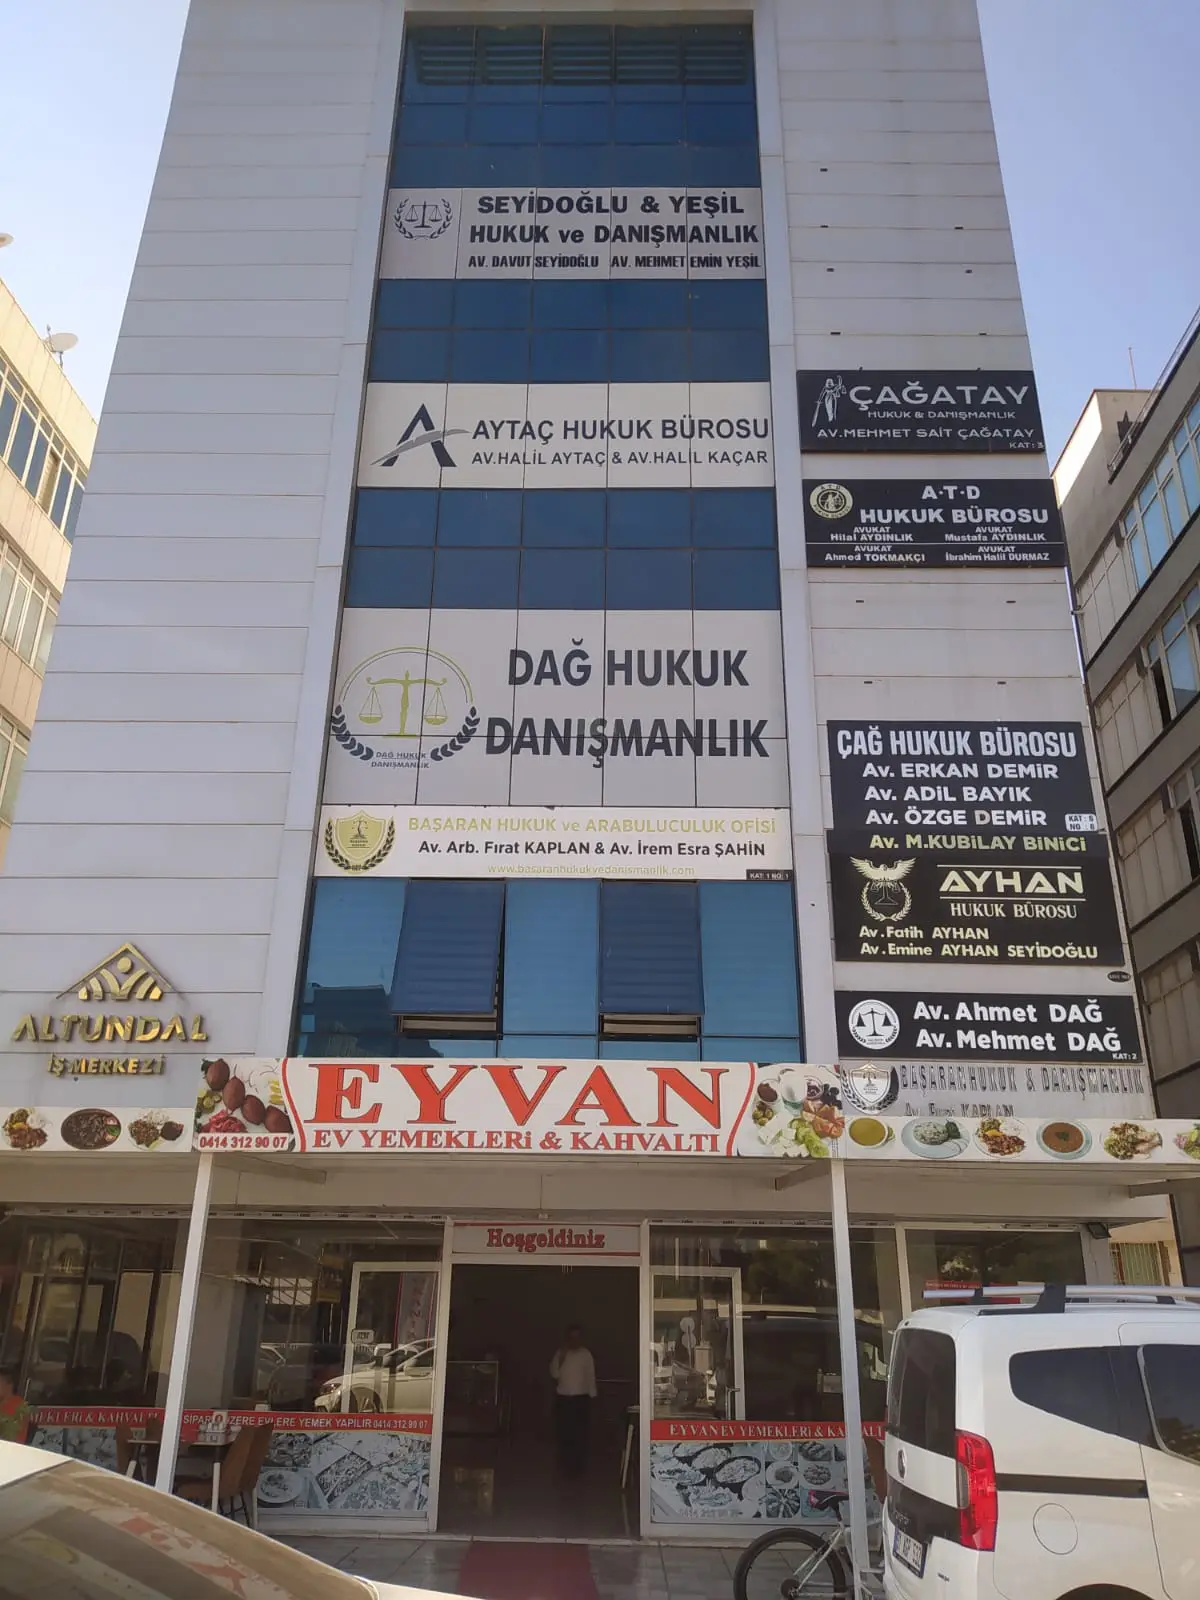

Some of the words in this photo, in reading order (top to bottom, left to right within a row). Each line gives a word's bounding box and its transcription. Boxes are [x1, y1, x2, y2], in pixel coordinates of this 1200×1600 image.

[478, 190, 628, 214] SEYİDOĞLU
[640, 195, 660, 214] &
[668, 191, 745, 219] YEŞİL
[470, 225, 550, 243] HUKUK
[558, 229, 585, 243] ve
[594, 225, 759, 248] DANIŞMANLIK
[468, 255, 489, 268] AV.
[491, 255, 532, 268] DAVUT
[535, 253, 599, 268] SEYİDOĞLU
[611, 255, 632, 268] AV.
[634, 255, 686, 268] MEHMET
[690, 253, 722, 268] EMİN
[726, 253, 761, 269] YEŞİL
[849, 381, 1029, 411] ÇAĞATAY
[867, 411, 911, 419] HUKUK
[914, 411, 925, 419] &
[928, 411, 1017, 421] DANIŞMANLIK
[472, 420, 554, 445] AYTAÇ
[563, 419, 653, 440] HUKUK
[661, 414, 769, 439] BÜROSU
[916, 427, 952, 438] SAİT
[958, 427, 1034, 440] ÇAĞATAY
[551, 451, 606, 467] AYTAÇ
[611, 451, 623, 465] &
[708, 451, 768, 466] KAÇAR
[860, 509, 945, 524] HUKUK
[951, 505, 1049, 524] BÜROSU
[830, 533, 857, 542] Hilal
[860, 534, 914, 542] AYDINLIK
[853, 526, 891, 534] AVUKAT
[945, 533, 988, 542] Mustafa
[991, 533, 1047, 542] AYDINLIK
[975, 526, 1013, 534] AVUKAT
[864, 553, 926, 562] TOKMAKÇI
[983, 552, 1007, 561] Halil
[1008, 552, 1050, 561] DURMAZ
[508, 637, 592, 687] DAĞ
[607, 649, 750, 687] HUKUK
[485, 717, 770, 768] DANIŞMANLIK
[837, 725, 883, 759] ÇAĞ
[890, 730, 974, 756] HUKUK
[980, 727, 1078, 757] BÜROSU
[397, 751, 427, 760] HUKUK
[862, 762, 895, 778] Av.
[901, 763, 979, 778] ERKAN
[864, 785, 897, 801] Av.
[962, 786, 1032, 802] BAYIK
[865, 809, 898, 825] Av.
[904, 806, 968, 825] ÖZGE
[408, 817, 492, 832] BAŞARAN
[497, 817, 556, 832] HUKUK
[562, 821, 581, 832] ve
[585, 818, 726, 833] ARABULUCULUK
[731, 817, 776, 833] OFİSİ
[418, 841, 442, 853] Av.
[446, 841, 479, 854] Arb.
[484, 842, 520, 854] Fırat
[525, 842, 594, 855] KAPLAN
[595, 843, 605, 855] &
[610, 843, 633, 855] Av.
[638, 840, 673, 855] İrem
[678, 842, 710, 856] Esra
[715, 841, 765, 858] ŞAHİN
[869, 834, 899, 849] Av.
[938, 870, 1085, 895] AYHAN
[951, 903, 1006, 918] HUKUK
[1013, 901, 1078, 919] BÜROSU
[932, 927, 990, 940] AYHAN
[941, 945, 999, 957] AYHAN
[1007, 941, 1099, 959] SEYİDOĞLU
[913, 1001, 949, 1020] Av.
[955, 1002, 1037, 1022] Ahmet
[1049, 999, 1103, 1023] DAĞ
[11, 1013, 209, 1042] ALTUNDAL
[916, 1029, 952, 1048] Av.
[958, 1029, 1056, 1050] Mehmet
[1067, 1027, 1122, 1051] DAĞ
[304, 1063, 730, 1130] EYVAN
[200, 1136, 228, 1149] 0414
[231, 1136, 252, 1149] 312
[254, 1136, 271, 1149] 90
[273, 1136, 287, 1149] 07
[312, 1130, 355, 1149] EV
[539, 1131, 562, 1151] &
[570, 1131, 720, 1153] KAHVALTI
[486, 1229, 606, 1253] Hoşgeldiniz
[299, 1417, 332, 1428] YEMEK
[669, 1423, 719, 1436] EYVAN
[814, 1425, 824, 1438] &
